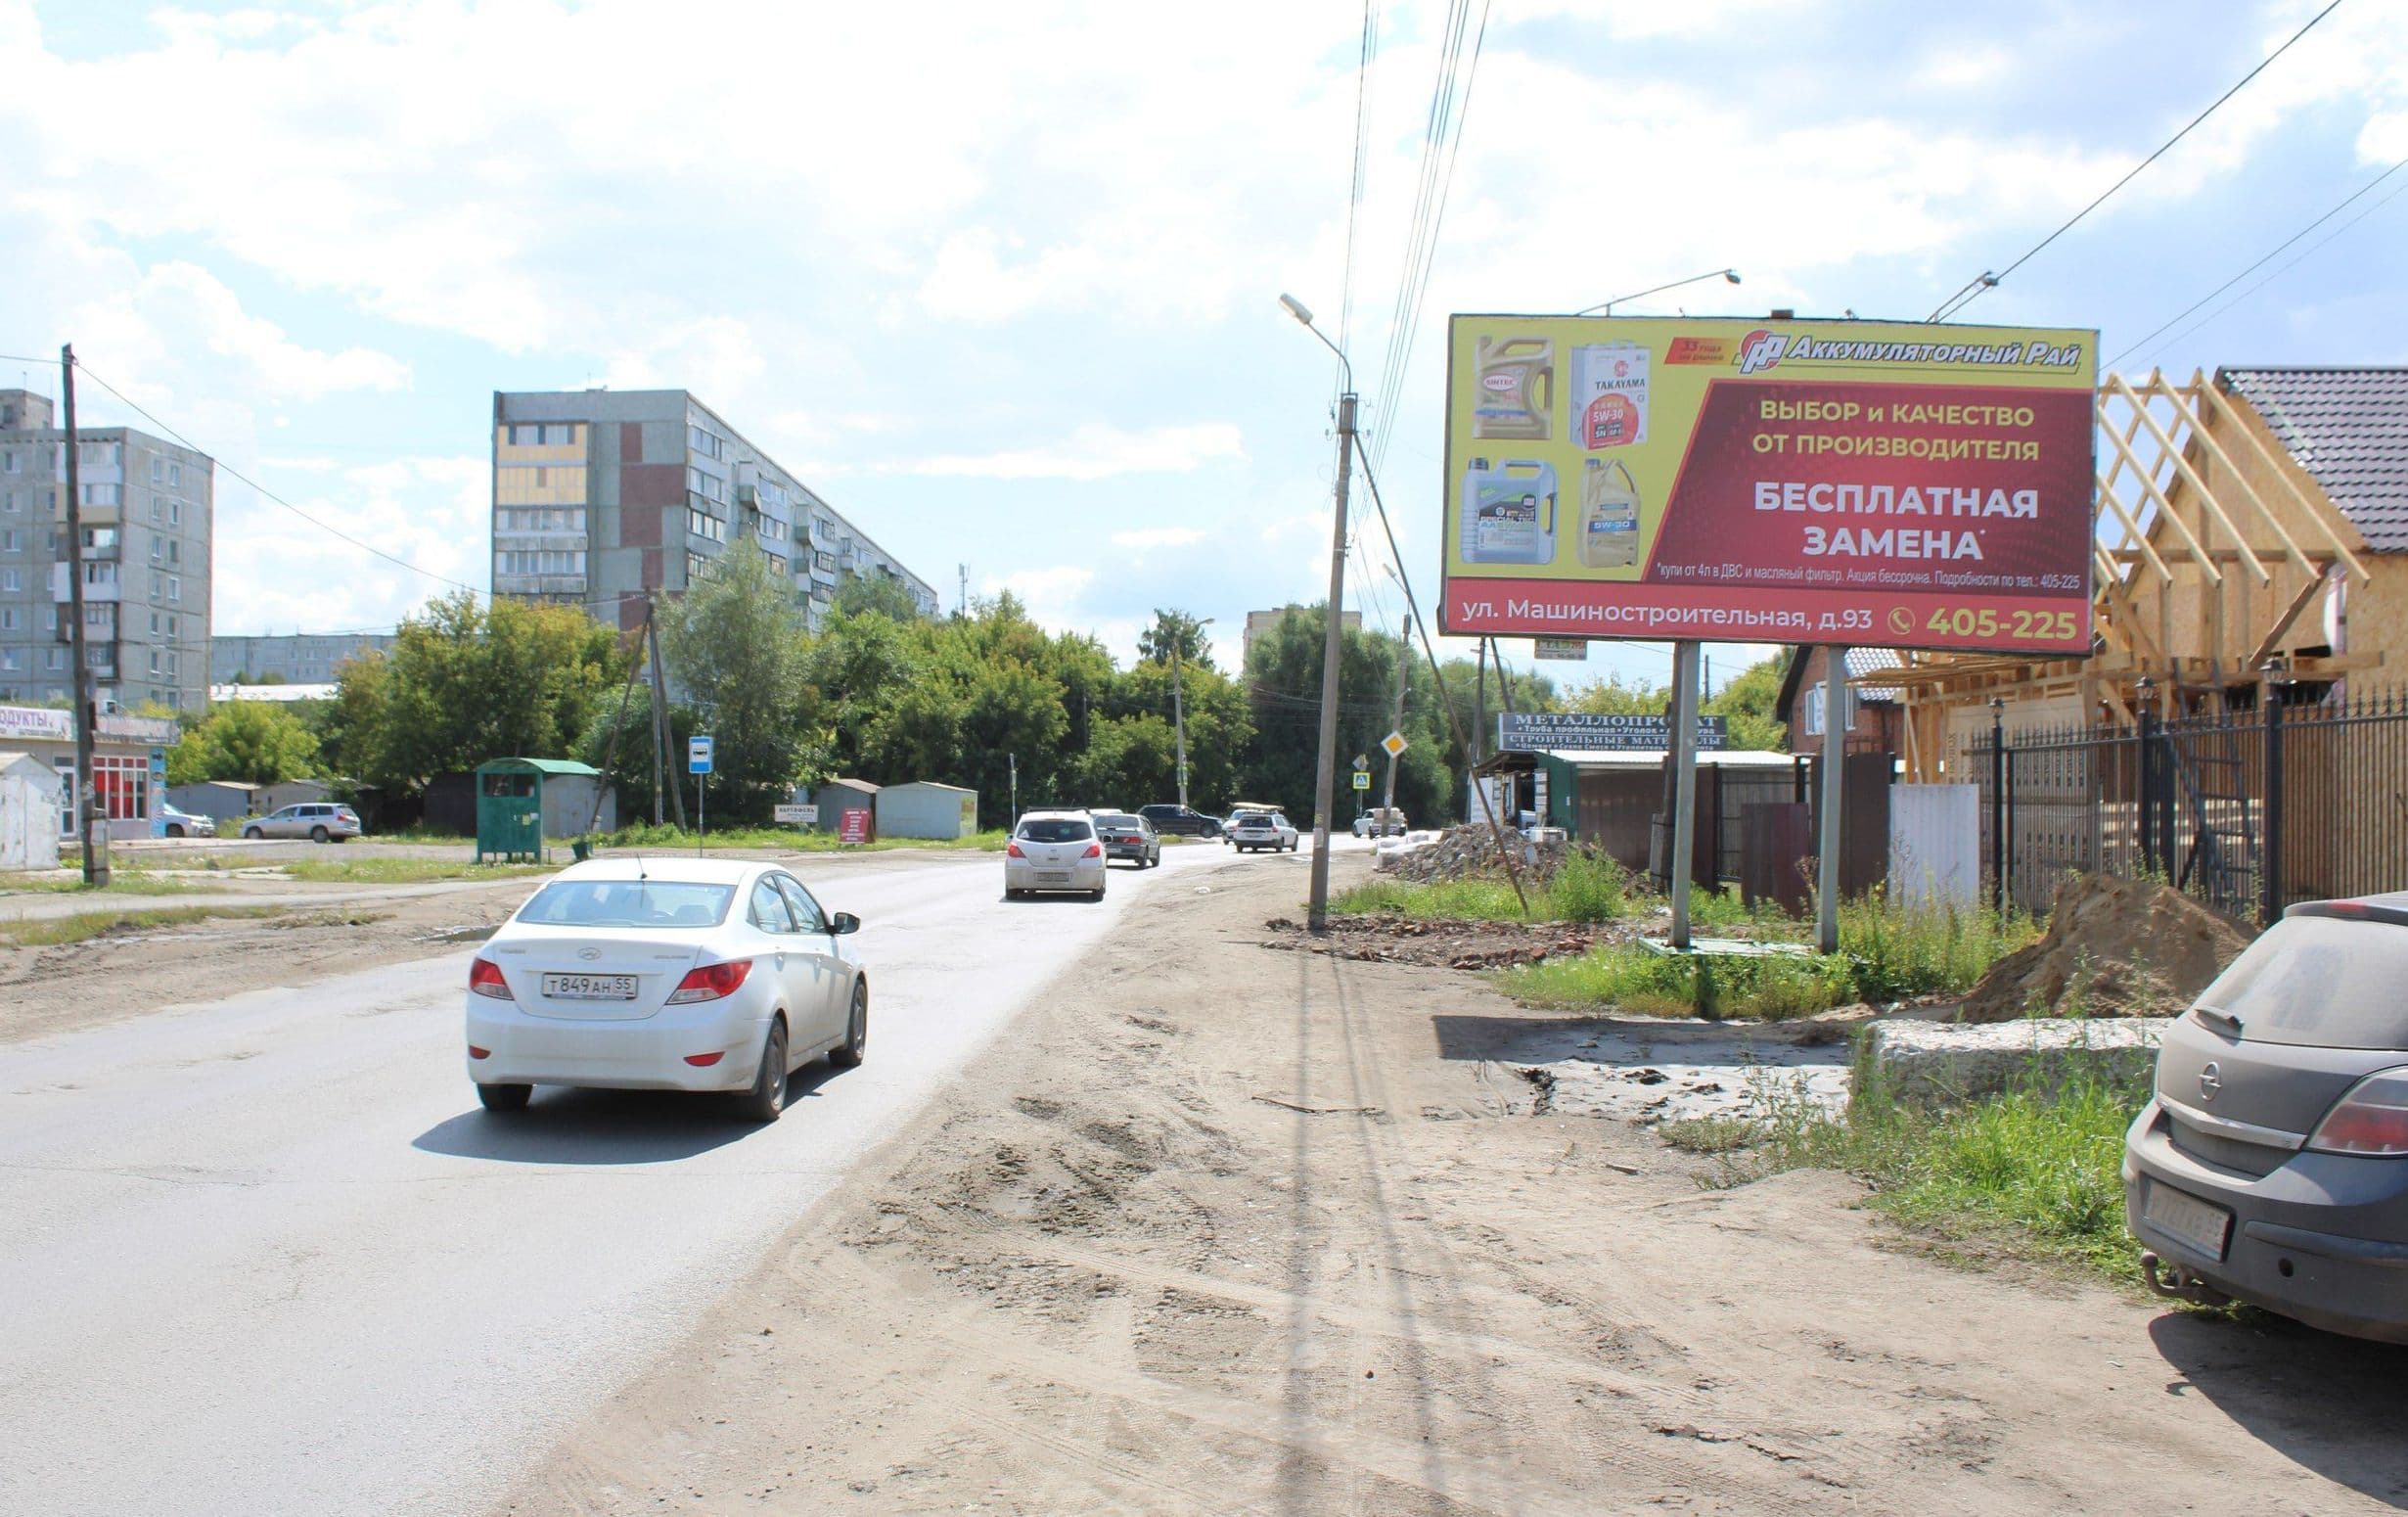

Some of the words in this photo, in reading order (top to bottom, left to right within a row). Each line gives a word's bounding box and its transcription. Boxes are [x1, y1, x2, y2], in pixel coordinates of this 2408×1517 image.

[1595, 378, 1646, 391] TAKAYAMA
[1593, 409, 1624, 423] 5W-30
[1760, 399, 1861, 422] ВЫБОР
[1867, 406, 1885, 422] и
[1891, 403, 2035, 428] КАЧЕСТВО
[1752, 434, 1790, 454] ОТ
[1796, 435, 2040, 462] ПРОИЗВОДИТЕЛЯ
[1754, 481, 2039, 519] БЕСПЛАТНАЯ
[1594, 521, 1630, 529] 5W-30
[1684, 566, 1696, 577] от
[1712, 567, 1720, 577] в
[1720, 563, 1744, 579] ДВС
[1746, 567, 1752, 578] и
[1753, 565, 1803, 580] масляный
[1805, 566, 1844, 584] фильтр.
[1847, 567, 1878, 583] Акция
[1878, 569, 1932, 587] бессрочна.
[1934, 570, 2000, 589] Подробности
[2001, 575, 2014, 589] по
[2040, 574, 2080, 590] 405-225
[1462, 600, 1499, 622] ул.
[1507, 598, 1812, 632] Машиностроительная,
[1818, 608, 1874, 631] д.93
[1926, 607, 2077, 640] 405-225
[1509, 734, 1625, 745] СТРОИТЕЛЬНЫЕ
[1631, 736, 1720, 746] МАТЕЛЫ
